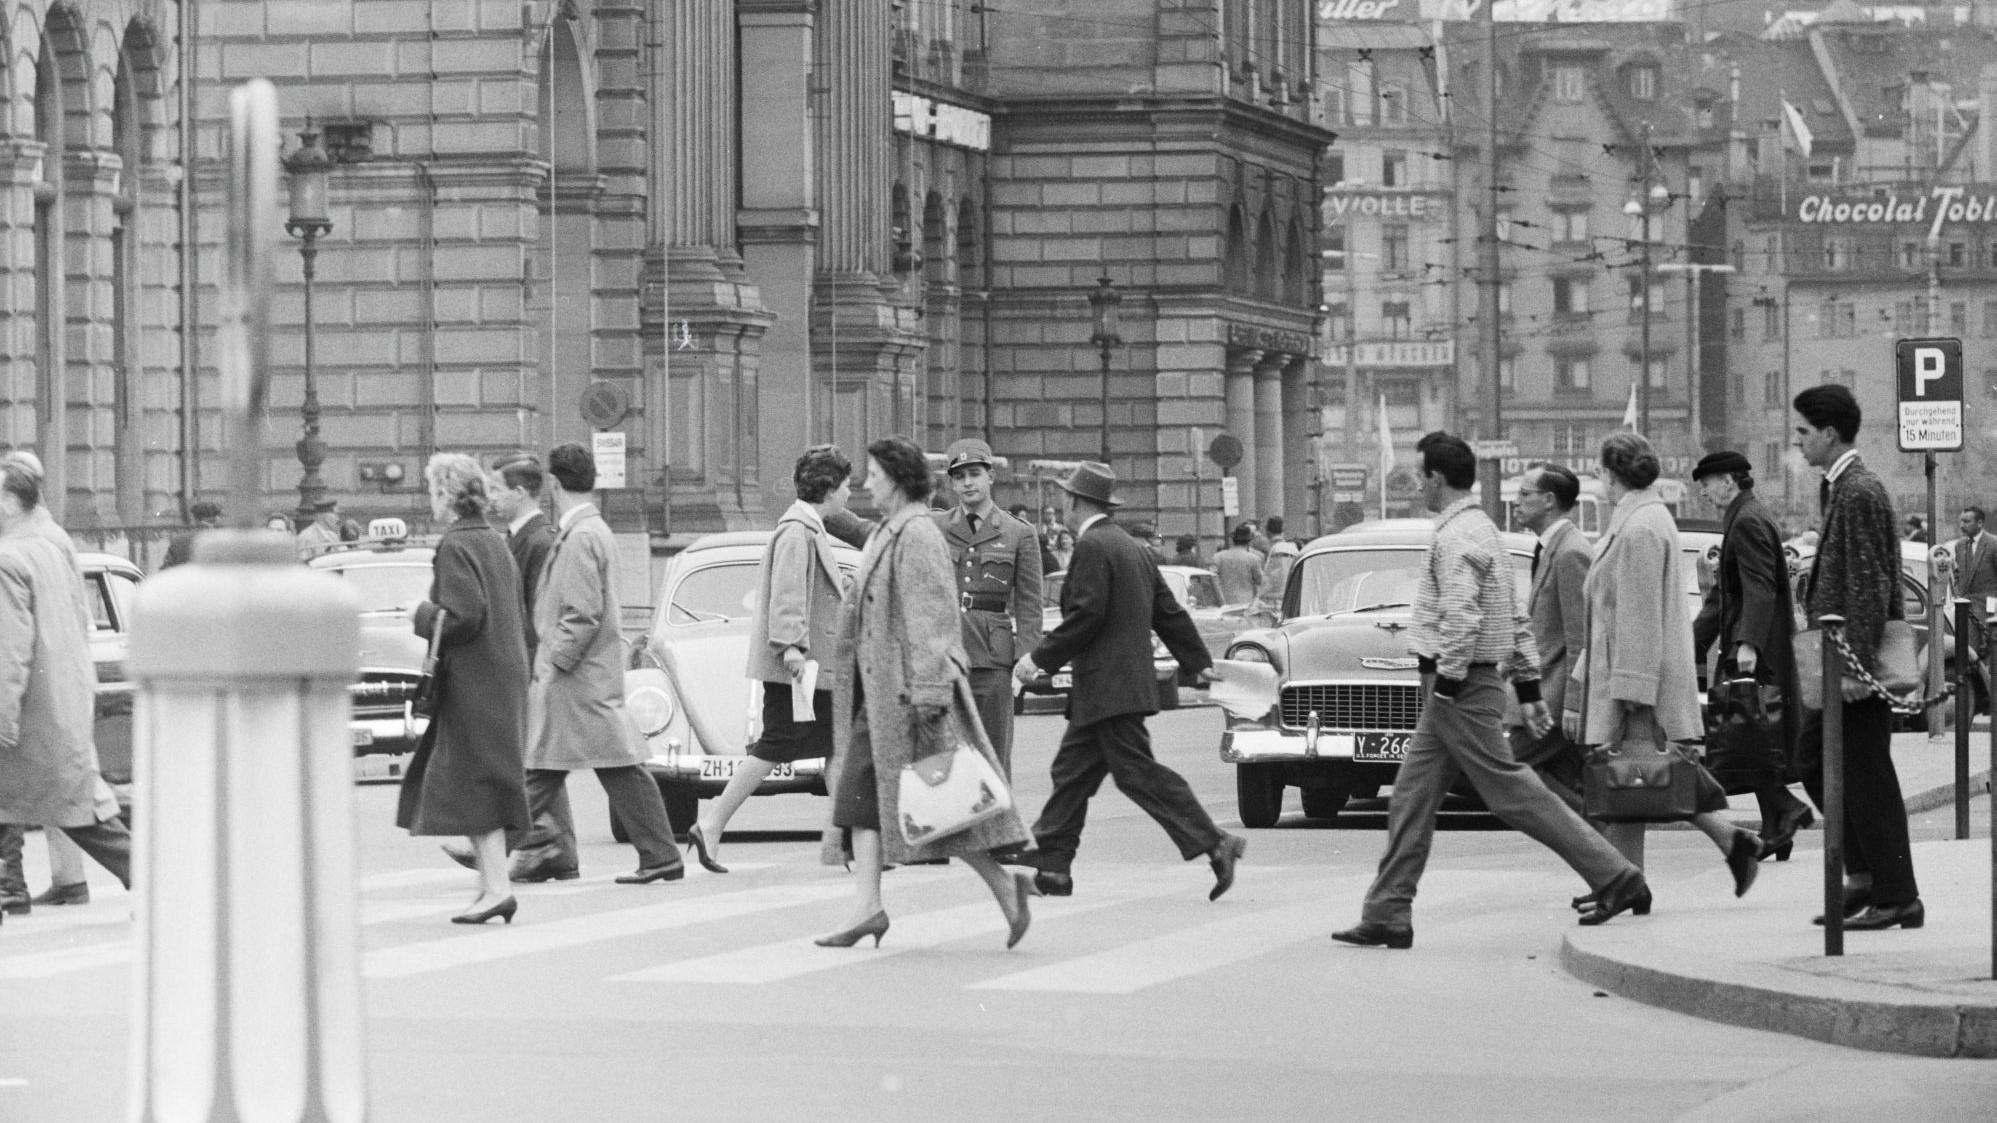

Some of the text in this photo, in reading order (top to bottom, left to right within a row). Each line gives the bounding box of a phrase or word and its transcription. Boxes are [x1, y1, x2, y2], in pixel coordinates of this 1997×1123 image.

[1927, 186, 1997, 241] Tobl
[1915, 347, 1945, 396] P
[1904, 406, 1956, 417] Durchgehend
[1906, 416, 1956, 426] nur während
[1906, 428, 1956, 442] 15 Minuten
[373, 524, 400, 536] TAXI
